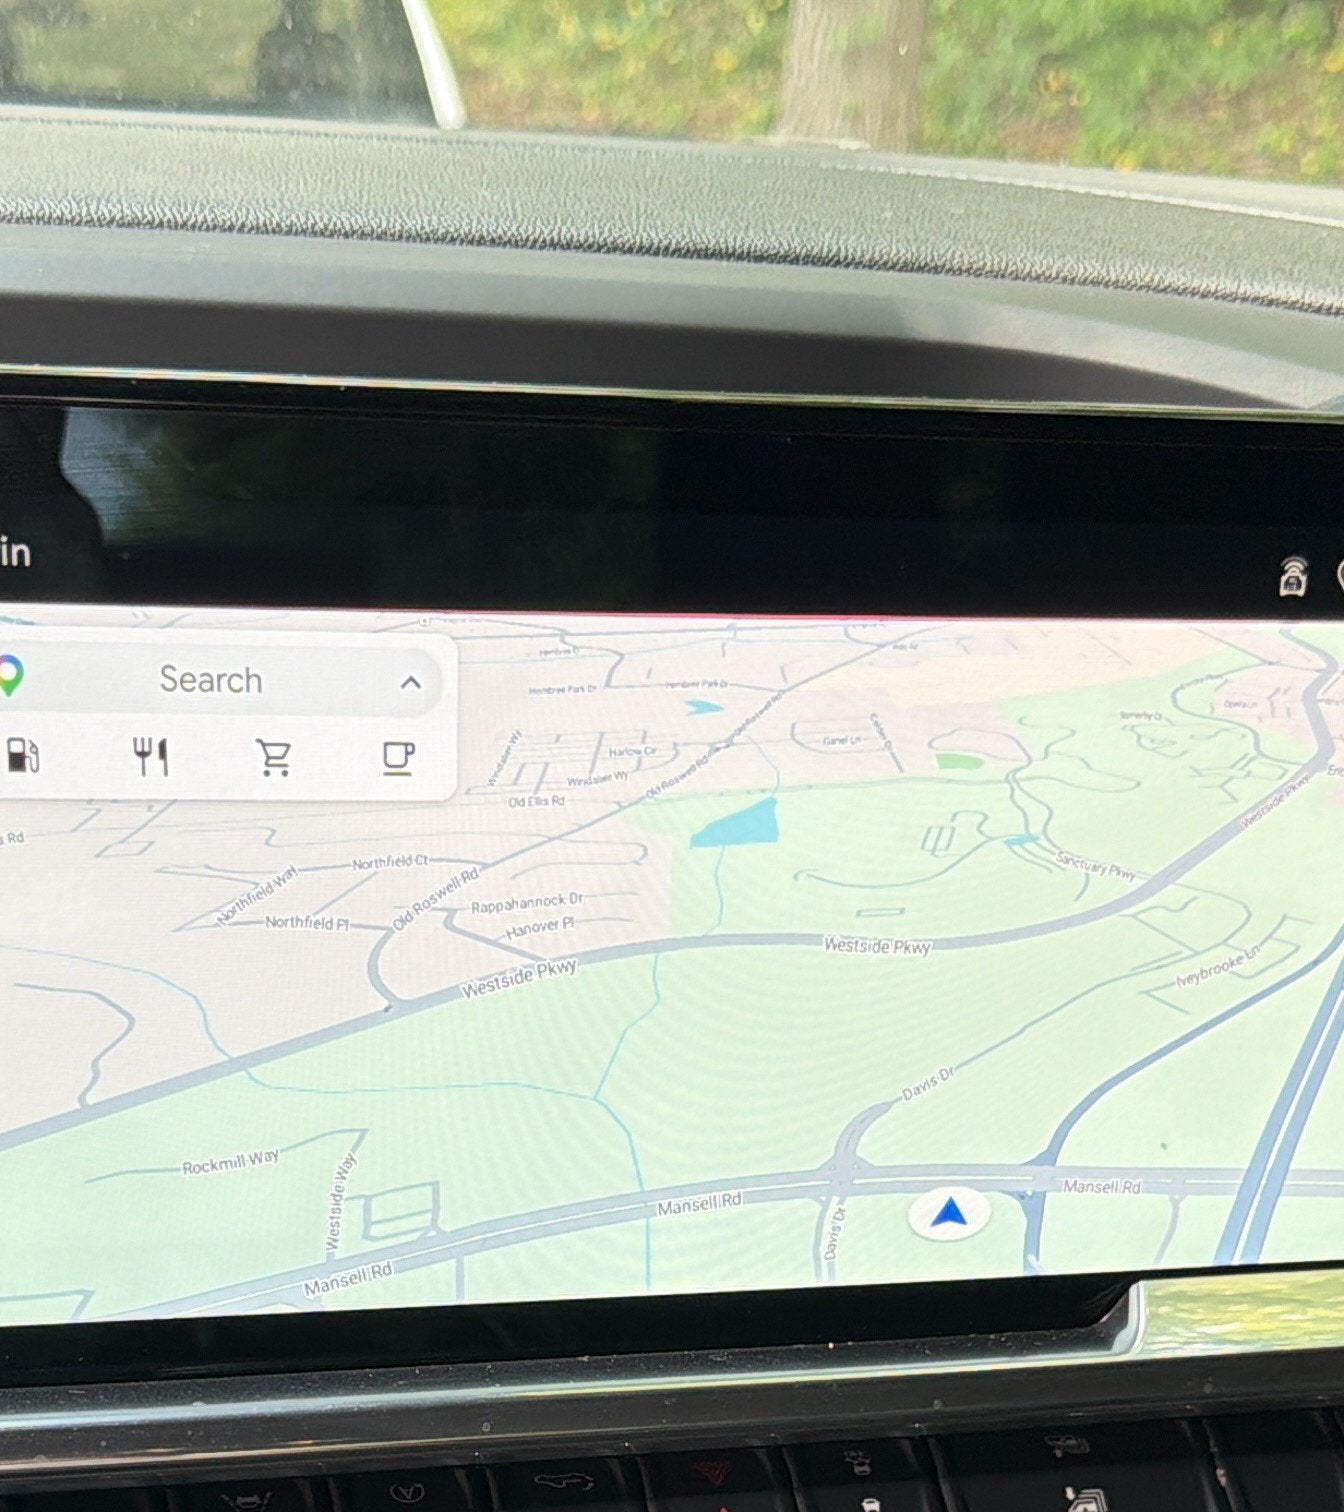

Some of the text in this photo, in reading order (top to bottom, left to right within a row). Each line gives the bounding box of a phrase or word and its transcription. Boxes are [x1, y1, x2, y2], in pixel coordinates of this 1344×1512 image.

[159, 666, 263, 694] Search
[567, 684, 585, 694] Park
[509, 796, 525, 808] Old
[552, 796, 565, 806] Rd
[1241, 775, 1310, 828] Westside Pkwy
[7, 831, 25, 843] Rd
[352, 854, 429, 871] Northfield Ct
[1056, 850, 1137, 883] Sanctuary Pkwy
[216, 865, 299, 925] Northfield Way
[392, 868, 480, 932] Old Roswell Rd
[471, 891, 583, 915] Rappahannock Dr
[265, 915, 350, 931] Northfield Pl
[506, 916, 575, 941] Hanover Pl
[824, 935, 931, 957] Westside Pkwy
[462, 958, 577, 999] Westside Pkwy
[1176, 945, 1261, 988] Iveybrooke Ln
[902, 1066, 956, 1102] Davis Dr
[182, 1148, 280, 1177] Rockmill Way
[1063, 1177, 1142, 1196] Mansell Rd
[325, 1152, 358, 1251] Westside Way
[658, 1191, 742, 1216] Mansell Rd
[824, 1206, 846, 1262] Davis Dr
[304, 1261, 393, 1297] Mansell Rd
